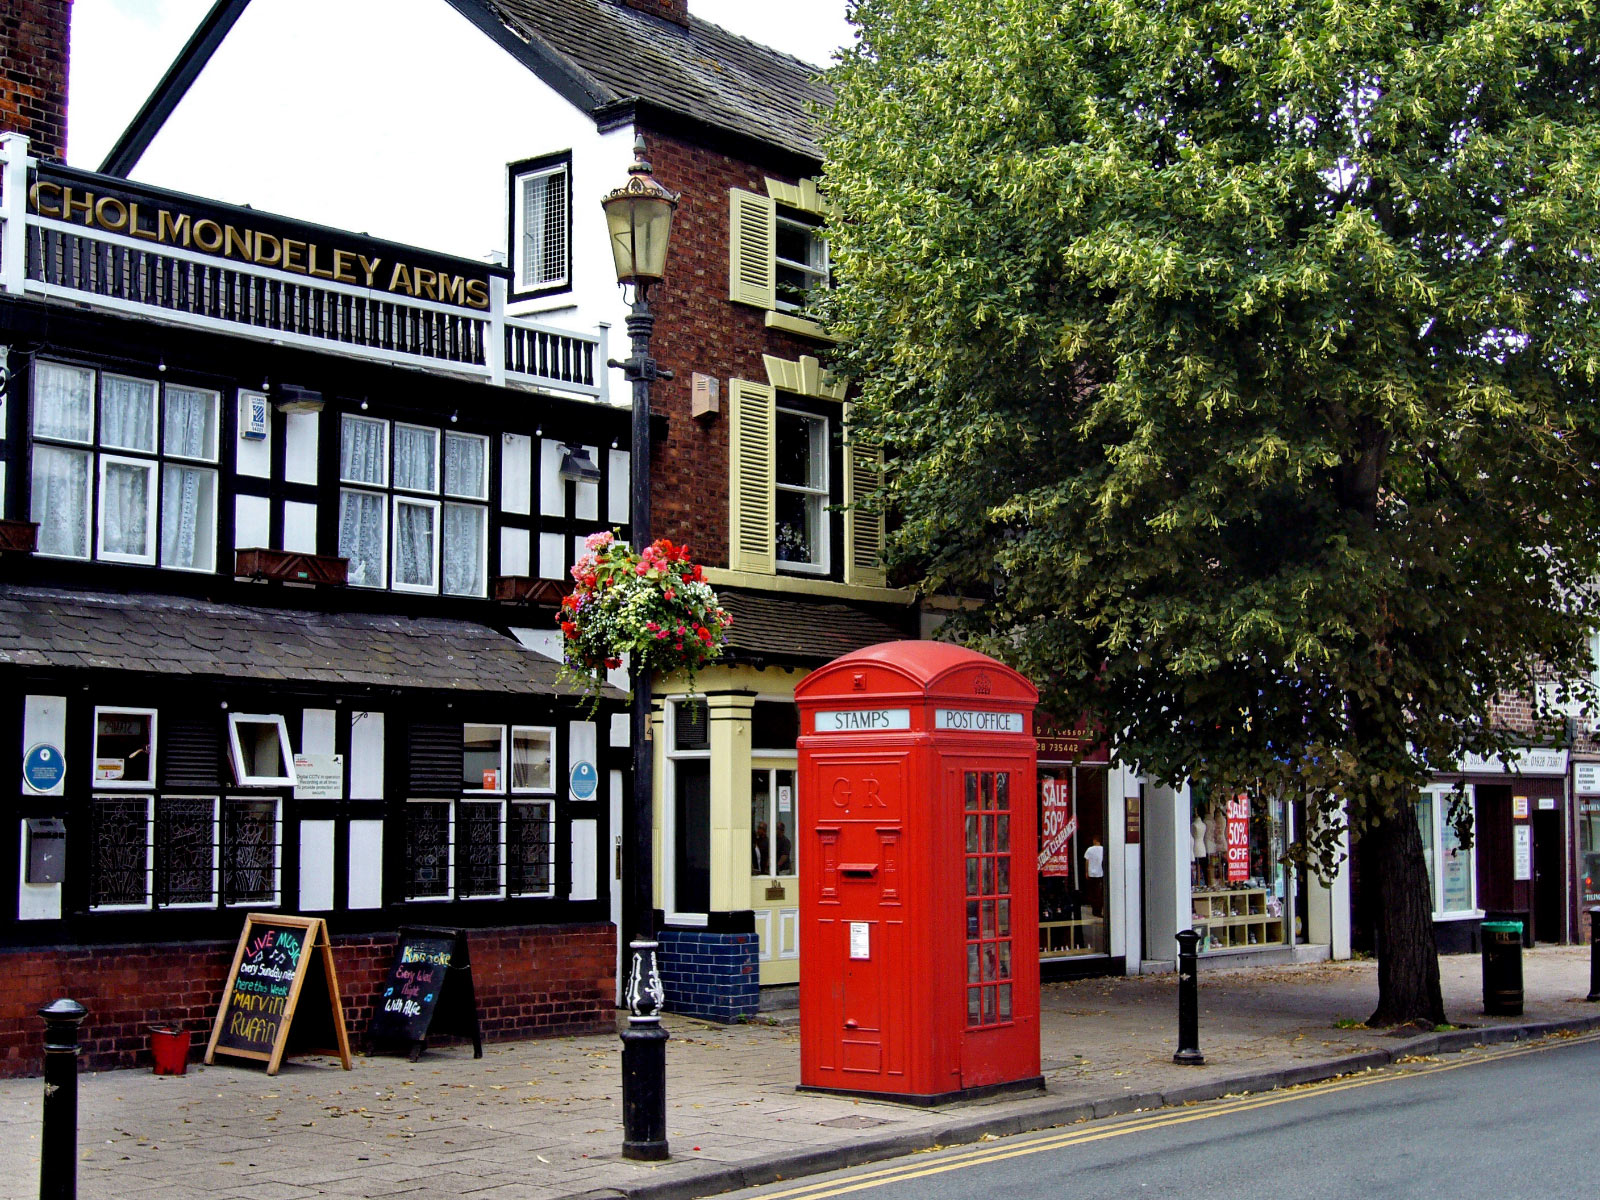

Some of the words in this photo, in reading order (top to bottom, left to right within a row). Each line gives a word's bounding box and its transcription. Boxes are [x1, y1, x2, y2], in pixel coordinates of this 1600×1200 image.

[29, 181, 382, 287] CHOLMONDELEY
[388, 262, 490, 309] ARMS
[835, 710, 890, 729] STAMPS
[946, 711, 973, 729] POST
[976, 713, 1012, 731] OFFICE
[1049, 743, 1079, 752] 735442
[832, 777, 852, 809] G
[861, 778, 887, 809] R
[1043, 783, 1067, 807] SALE
[1227, 799, 1247, 820] SALE
[1228, 822, 1248, 846] 50%
[1228, 847, 1247, 861] OFF
[245, 930, 275, 958] LIVE
[276, 932, 301, 966] MUSIC
[240, 962, 258, 976] every
[258, 963, 283, 981] Sunday
[282, 968, 296, 981] nite
[395, 964, 416, 984] Every
[236, 976, 253, 991] here
[401, 982, 420, 999] Night
[384, 998, 403, 1013] With
[230, 1011, 276, 1046] Ruffin
